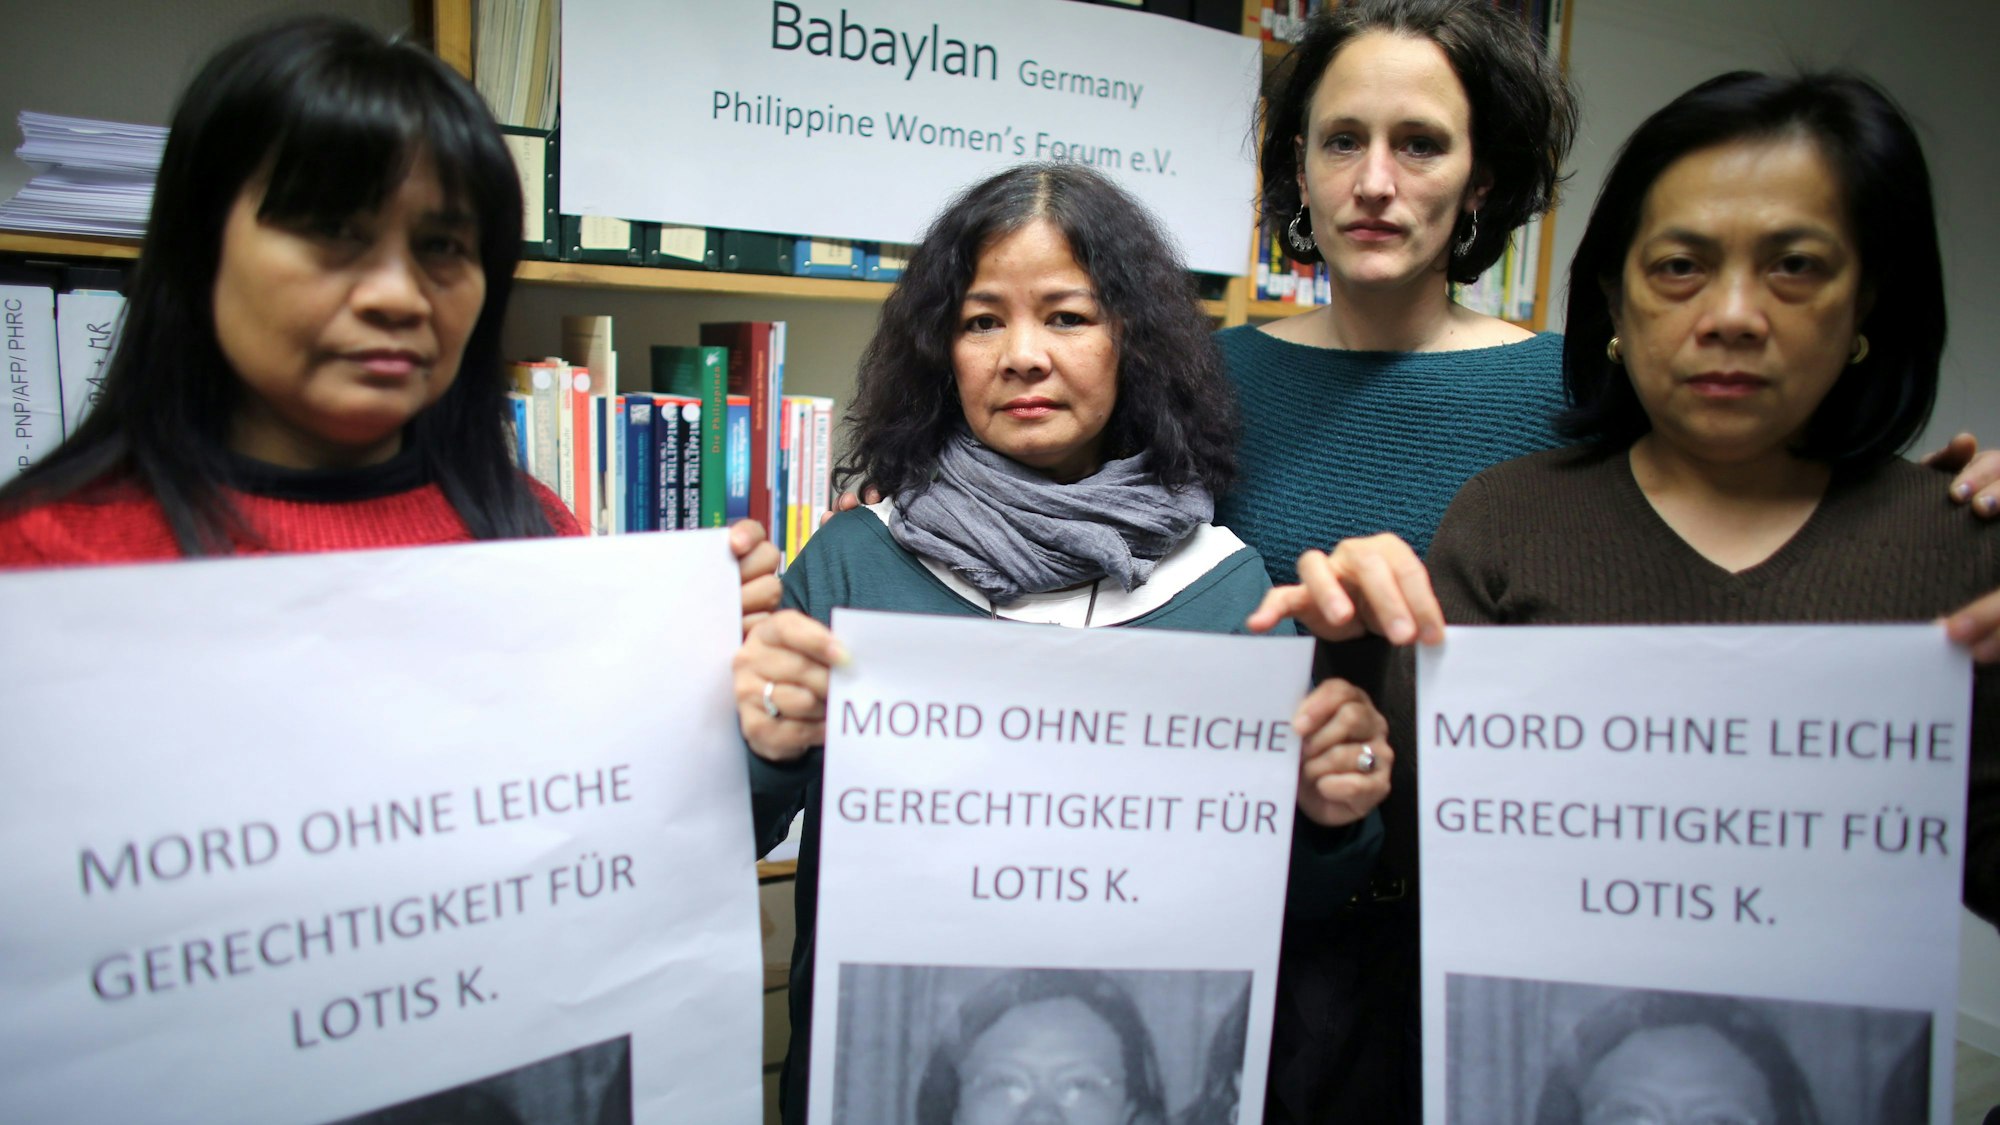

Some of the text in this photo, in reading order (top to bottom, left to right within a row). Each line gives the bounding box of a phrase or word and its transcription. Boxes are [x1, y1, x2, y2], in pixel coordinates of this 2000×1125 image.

[771, 0, 1144, 109] Babaylan Germany
[712, 90, 1177, 176] Philippine Women’s Forum e.V.
[4, 298, 26, 350] PHRC
[711, 365, 721, 453] Die Philippinen
[840, 700, 1292, 753] MORD OHNE LEICHE
[1434, 712, 1956, 763] MORD OHNE LEICHE
[79, 764, 634, 895] MORD OHNE LEICHE
[838, 787, 1279, 835] GERECHTIGKEIT FÜR
[1435, 797, 1950, 857] GERECHTIGKEIT FÜR
[971, 865, 1140, 904] LOTIS K.
[1580, 877, 1777, 926] LOTIS K.
[90, 850, 637, 1003] GERECHTIGKEIT FÜR
[290, 966, 500, 1050] LOTIS K.
